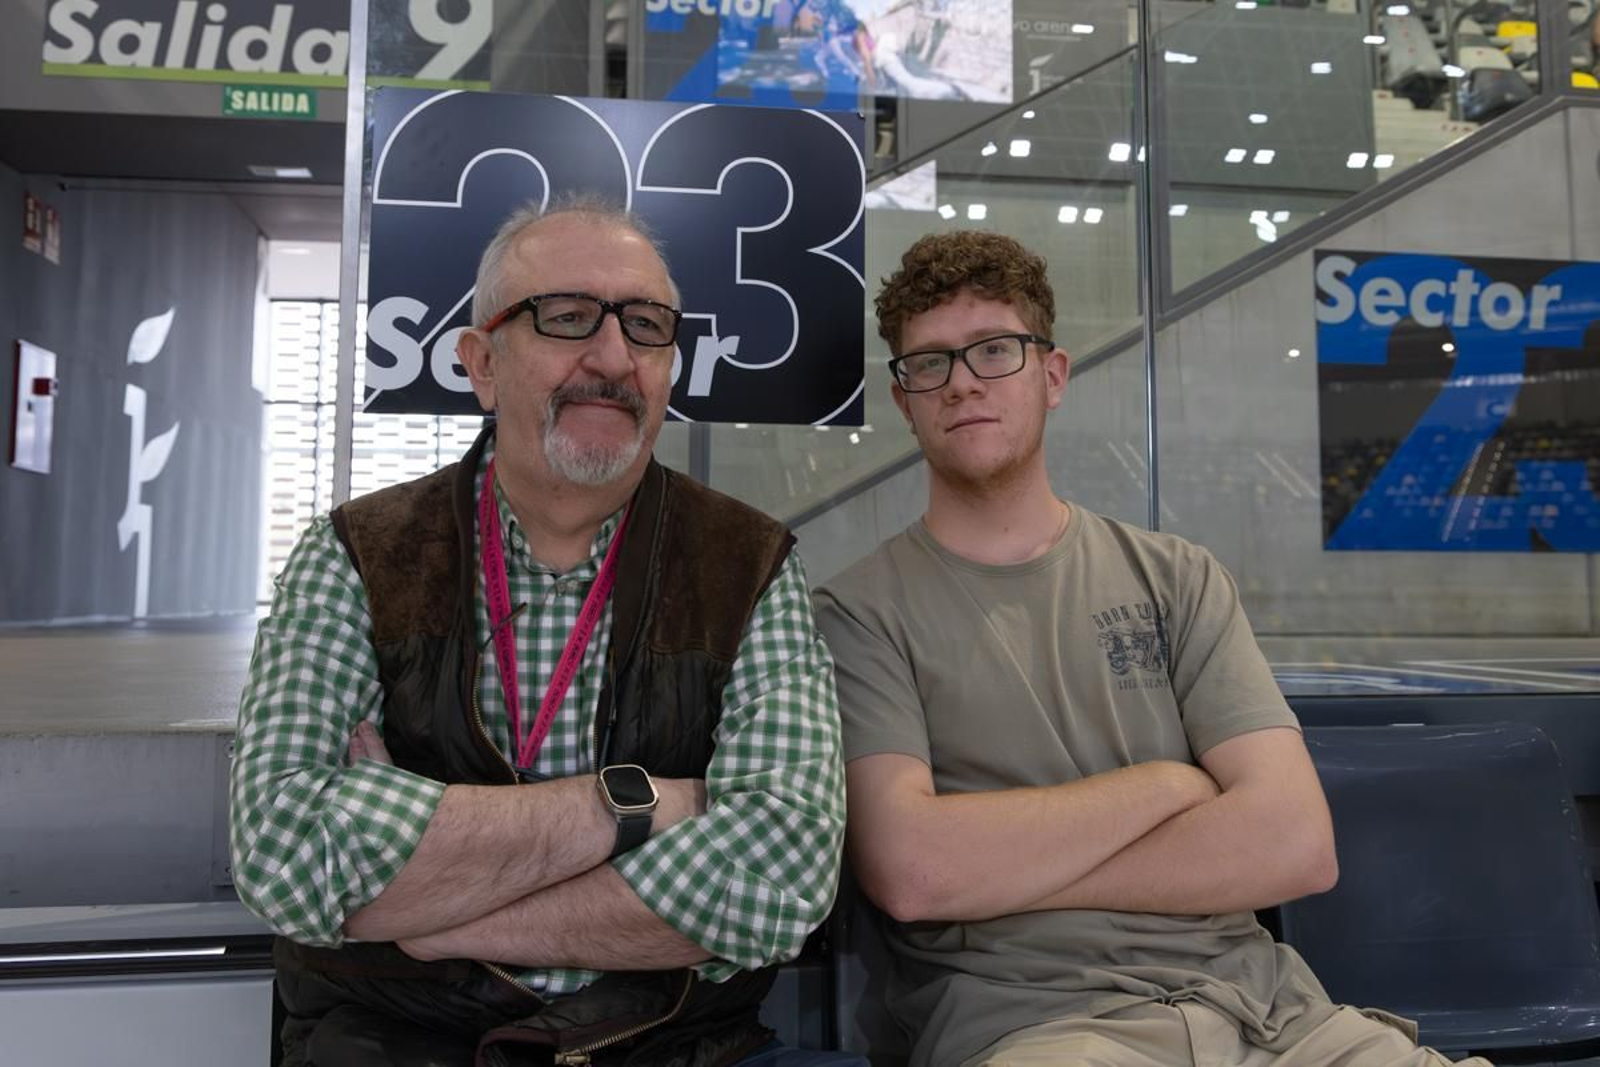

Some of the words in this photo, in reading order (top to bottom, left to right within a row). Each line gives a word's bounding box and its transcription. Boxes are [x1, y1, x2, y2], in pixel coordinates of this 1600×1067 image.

[43, 0, 349, 76] Salida
[409, 0, 493, 79] 9
[1033, 20, 1073, 33] aren
[231, 90, 310, 113] SALIDA
[1315, 255, 1562, 330] Sector
[364, 296, 740, 397] Ser
